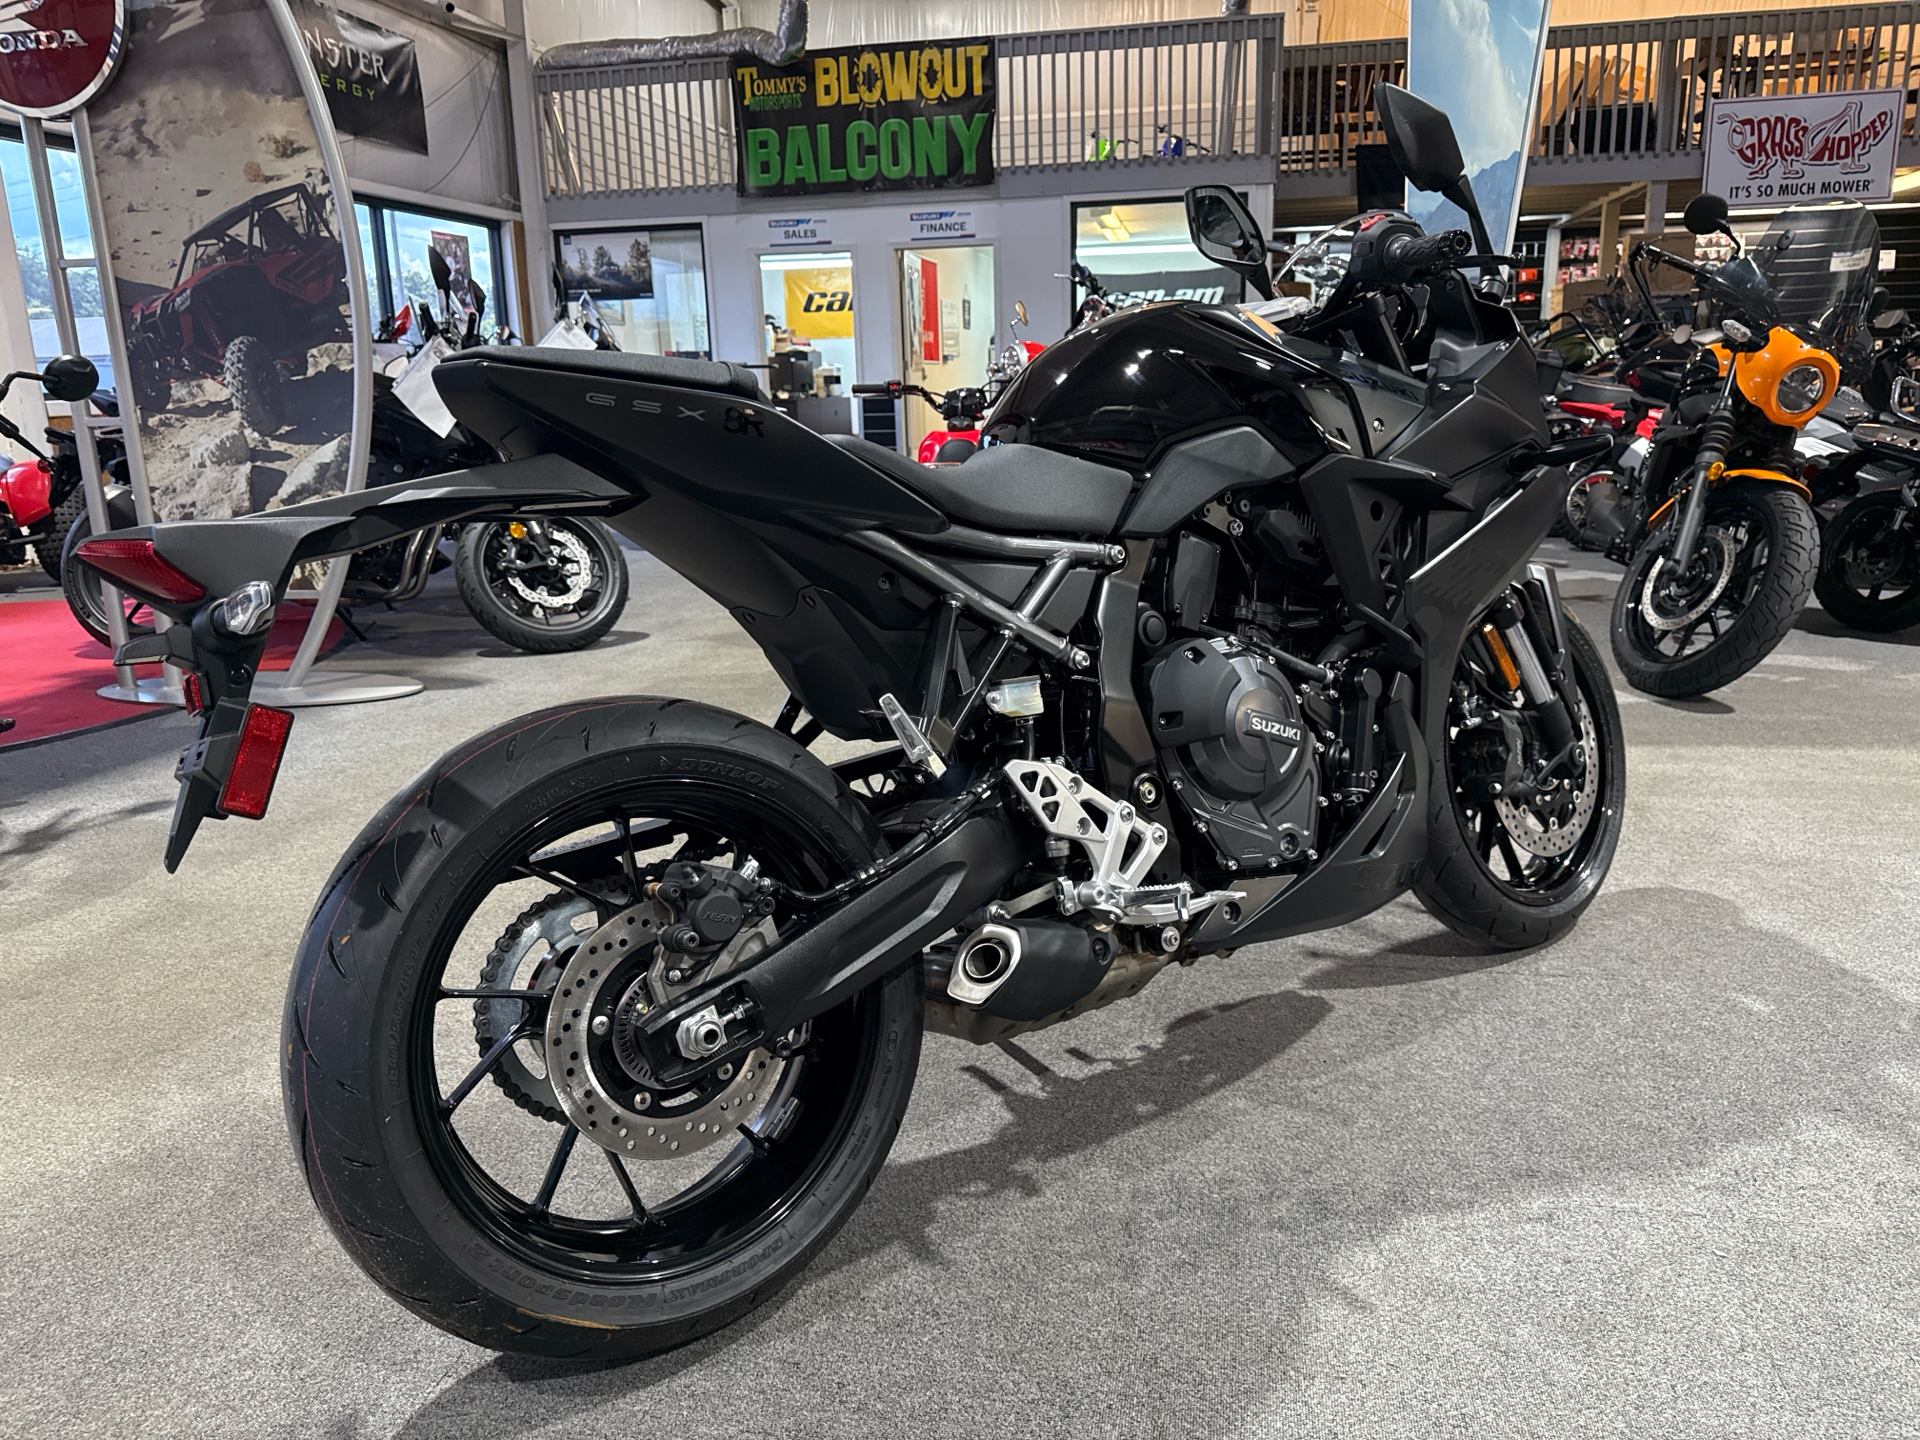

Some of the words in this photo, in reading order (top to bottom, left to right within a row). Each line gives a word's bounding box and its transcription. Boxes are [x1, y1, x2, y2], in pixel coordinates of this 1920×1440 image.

[303, 26, 390, 85] NSTER
[320, 73, 375, 101] ERGY
[736, 67, 807, 105] TOMMY'S
[814, 45, 989, 110] BLOWOUT
[749, 93, 802, 112] MOTORSPORTS
[747, 113, 989, 187] BALCONY
[1729, 185, 1752, 199] IT'S
[1757, 184, 1774, 197] SO
[1778, 182, 1816, 196] MUCH
[783, 229, 817, 239] SALES
[920, 222, 967, 233] FINANCE
[803, 291, 853, 313] ca
[1251, 717, 1301, 741] SUZUKI
[676, 758, 782, 792] DUNLOP
